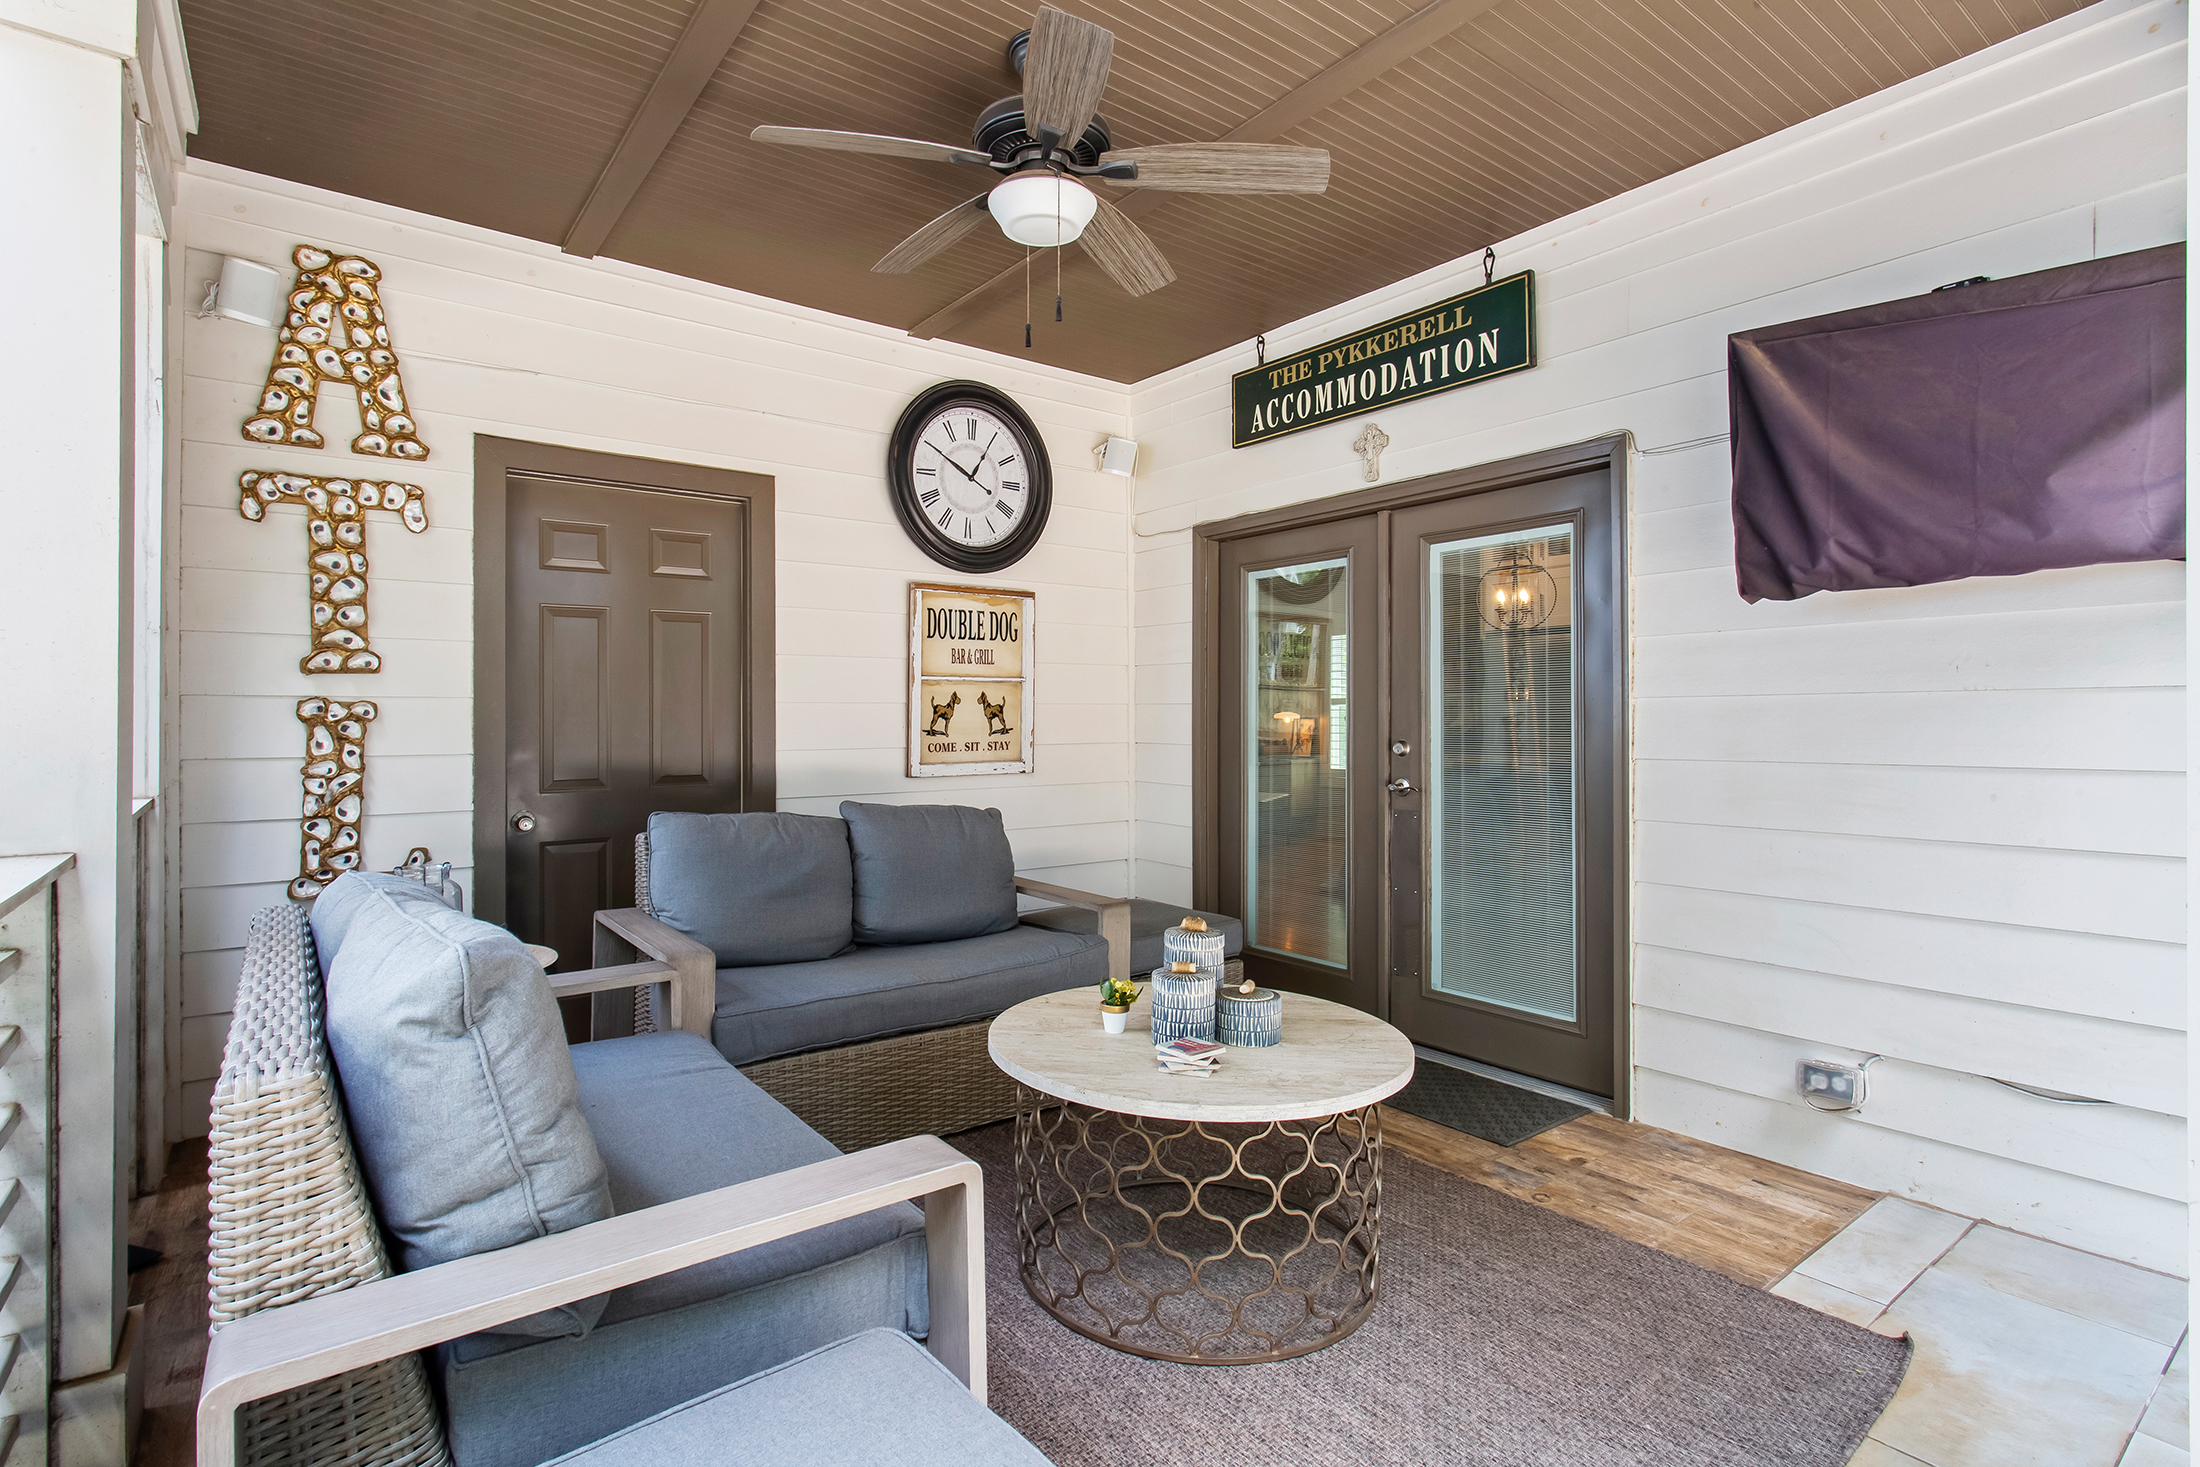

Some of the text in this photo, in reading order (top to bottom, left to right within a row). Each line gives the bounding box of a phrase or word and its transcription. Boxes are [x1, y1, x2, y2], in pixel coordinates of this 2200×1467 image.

[1269, 305, 1473, 389] THE PYKKERELL
[1250, 328, 1500, 433] ACCOMMODATION
[927, 607, 1018, 642] DOUBLE DOG
[951, 648, 995, 665] BAR & GRILL
[928, 742, 957, 753] COME
[965, 741, 980, 752] SIT
[987, 740, 1011, 752] STAY
